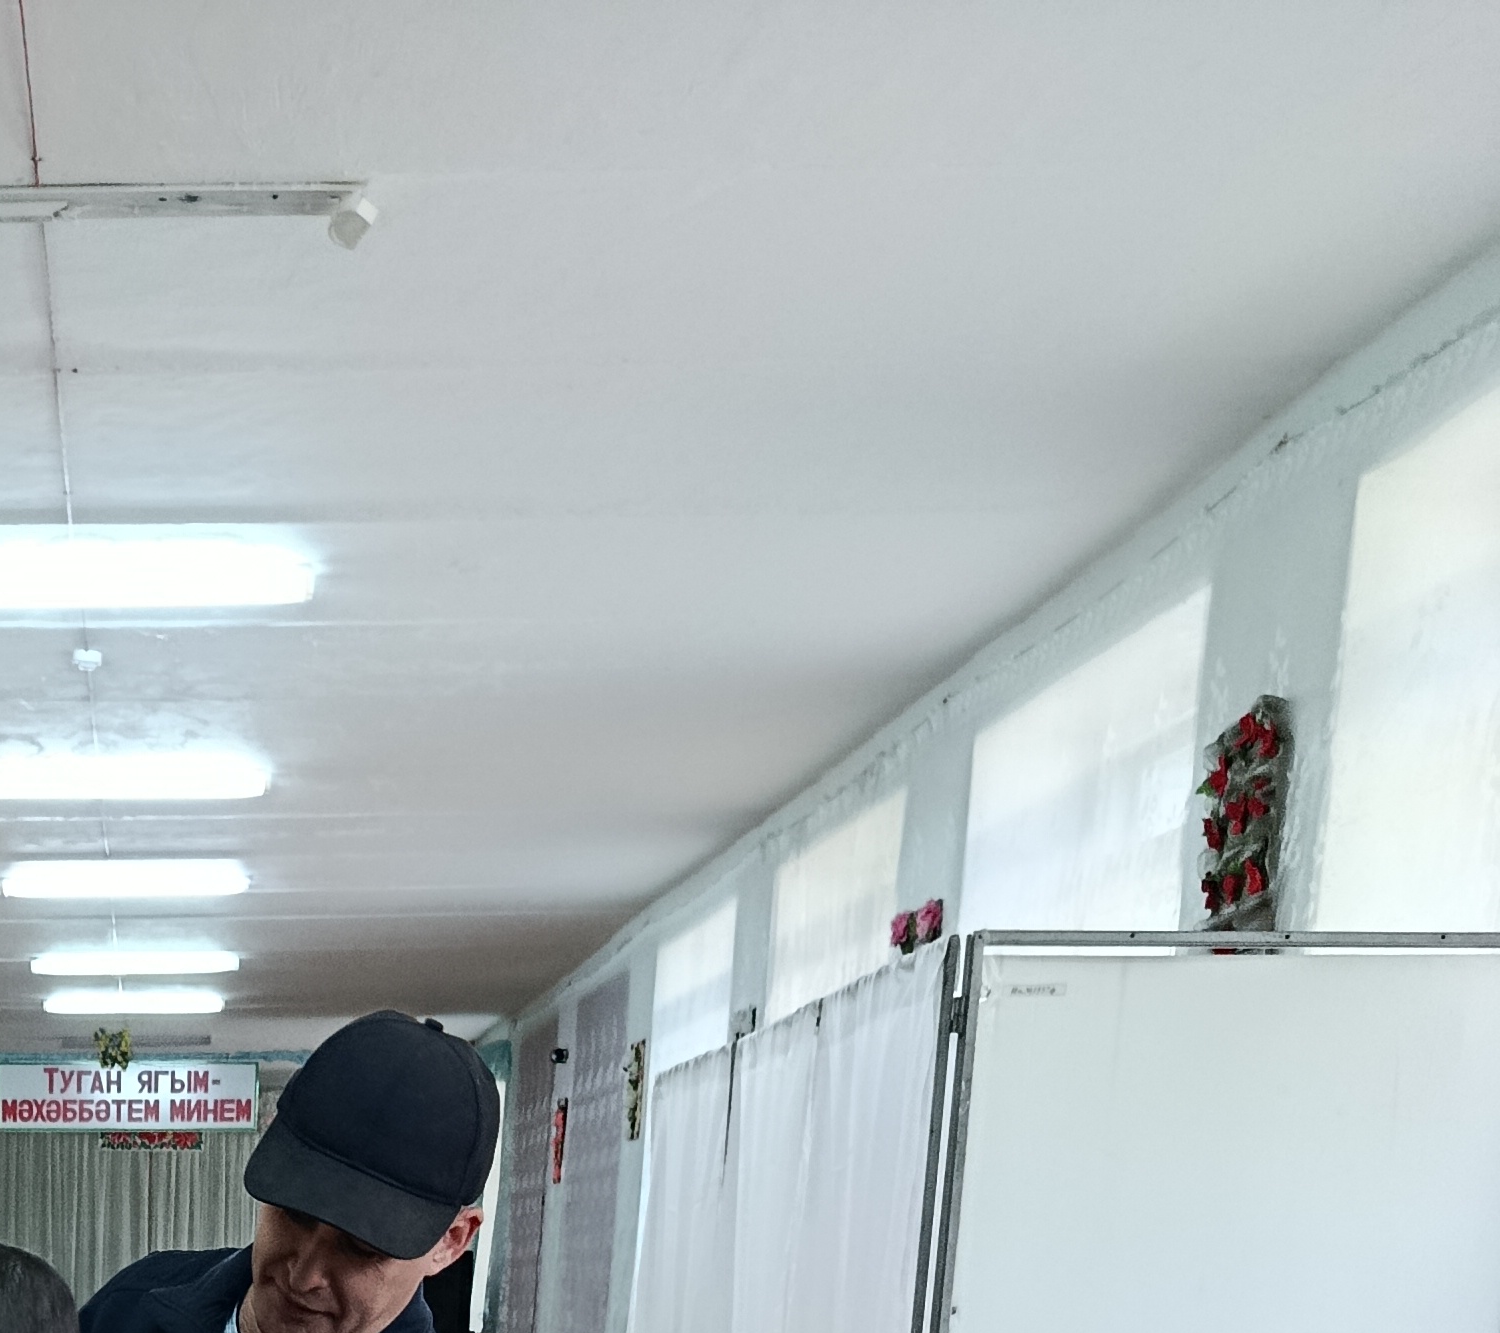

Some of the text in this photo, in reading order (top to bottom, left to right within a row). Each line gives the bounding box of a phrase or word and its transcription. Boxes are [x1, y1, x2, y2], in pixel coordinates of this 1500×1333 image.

[43, 1067, 221, 1094] ТУГАН ЯГЫМ-
[169, 1099, 252, 1123] МИНЕМ
